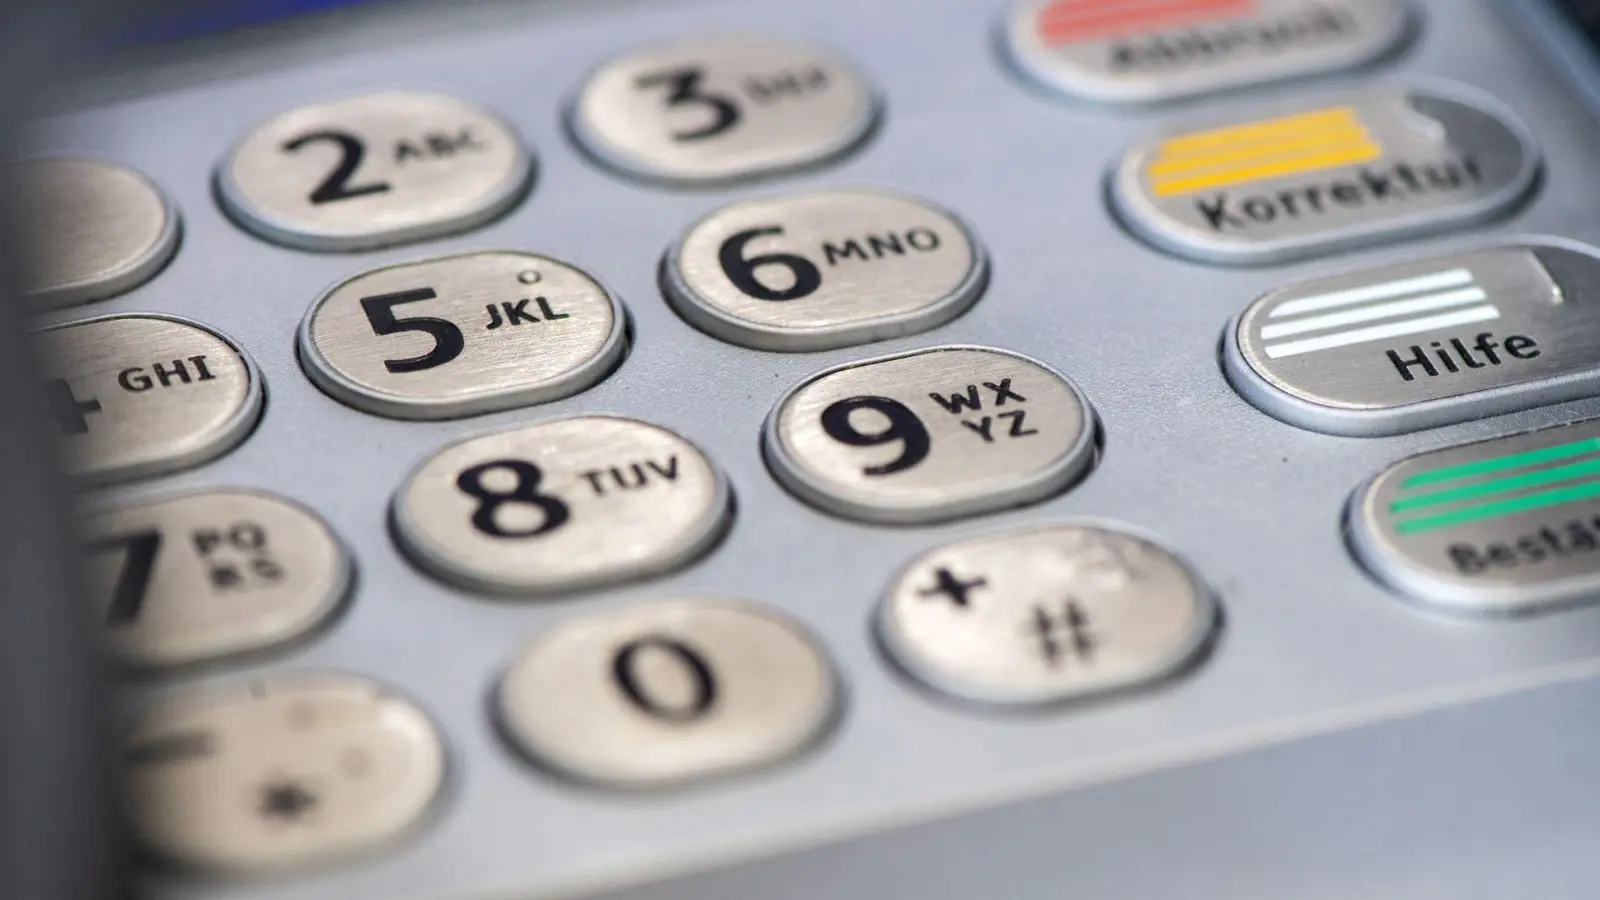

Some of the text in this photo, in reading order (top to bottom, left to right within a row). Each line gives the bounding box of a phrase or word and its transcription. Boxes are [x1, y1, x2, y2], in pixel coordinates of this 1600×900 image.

[632, 63, 741, 142] 3
[280, 130, 487, 204] 2 ABC
[1195, 157, 1484, 230] Korrektur
[718, 226, 941, 301] 6 MNO
[360, 287, 569, 373] 5 JKL
[1386, 333, 1541, 382] Hilfe
[117, 355, 216, 392] GHI
[820, 379, 1027, 476] 9 WX
[961, 410, 1039, 443] YZ
[456, 454, 680, 539] 8 TUV
[85, 527, 161, 630] 7
[611, 634, 718, 725] 0
